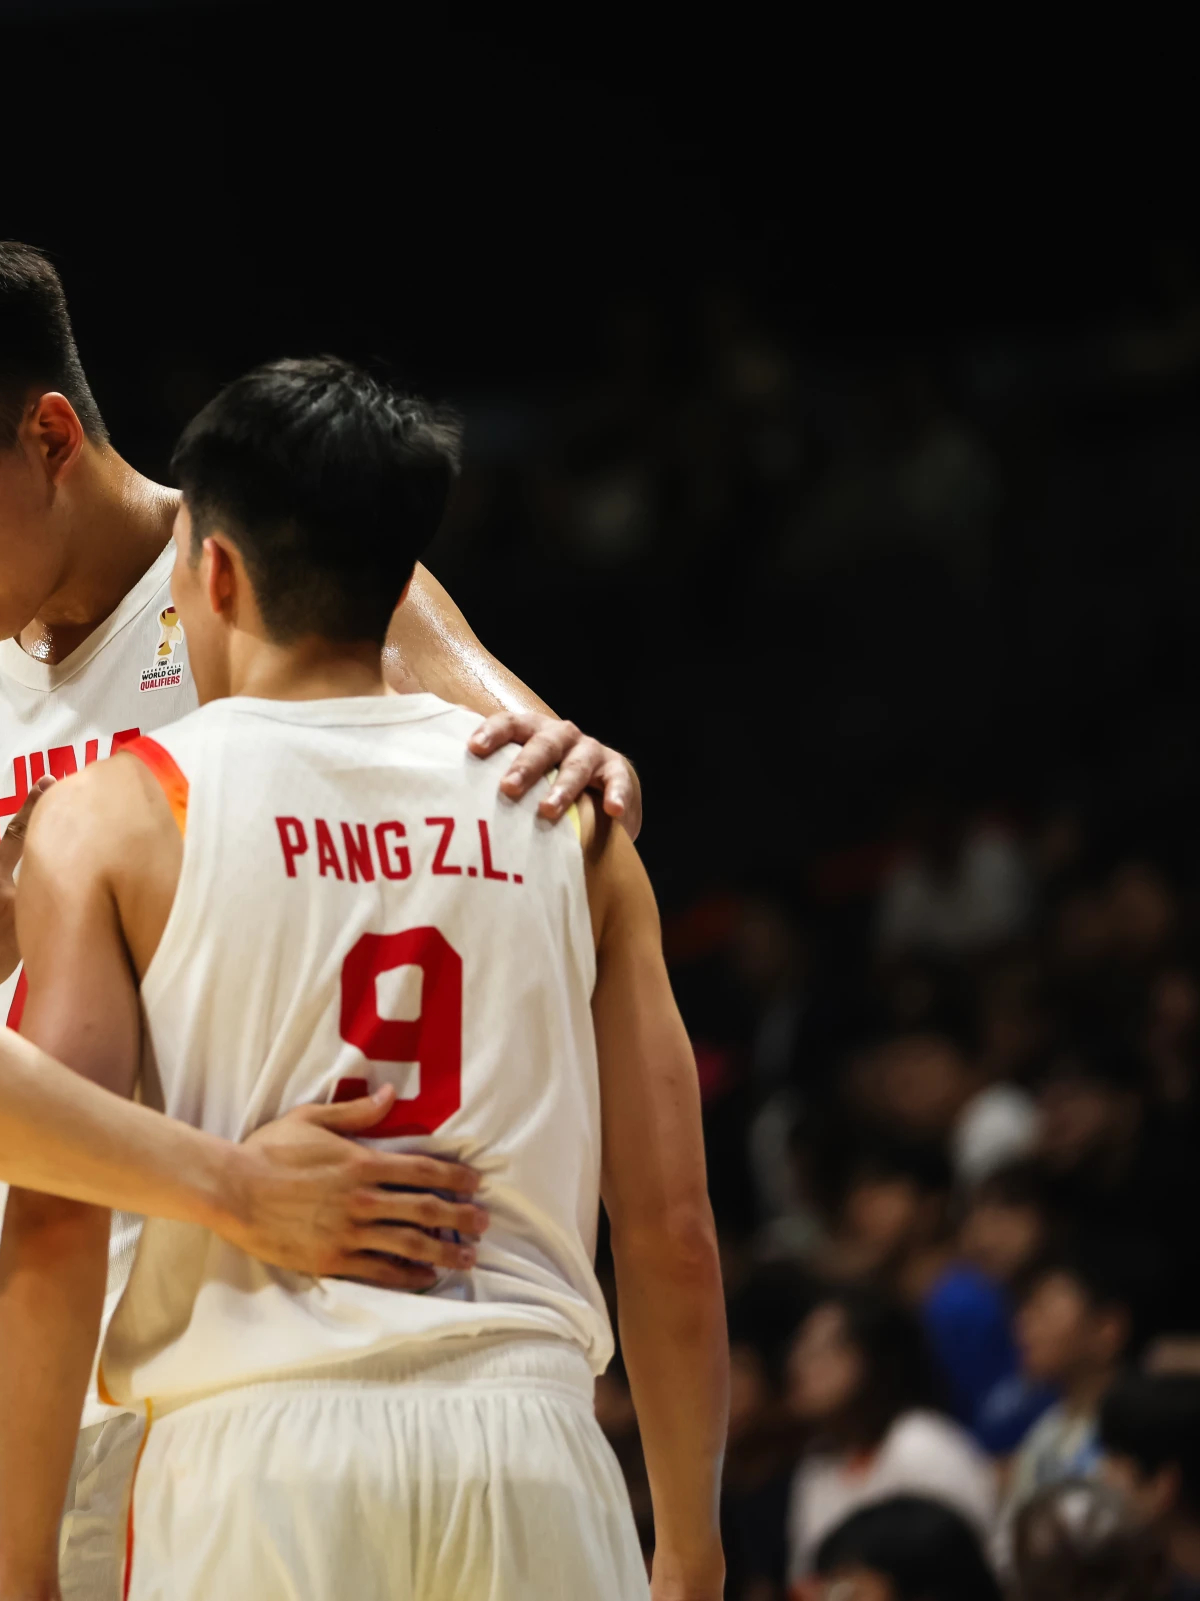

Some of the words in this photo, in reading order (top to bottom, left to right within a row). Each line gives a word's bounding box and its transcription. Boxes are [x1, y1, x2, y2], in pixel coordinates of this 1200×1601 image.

[140, 675, 180, 691] QUALIFIERS
[142, 670, 167, 681] WORLD
[167, 667, 182, 676] CUP
[274, 816, 413, 884] PANG
[424, 816, 524, 884] Z.L.
[329, 925, 463, 1139] 9
